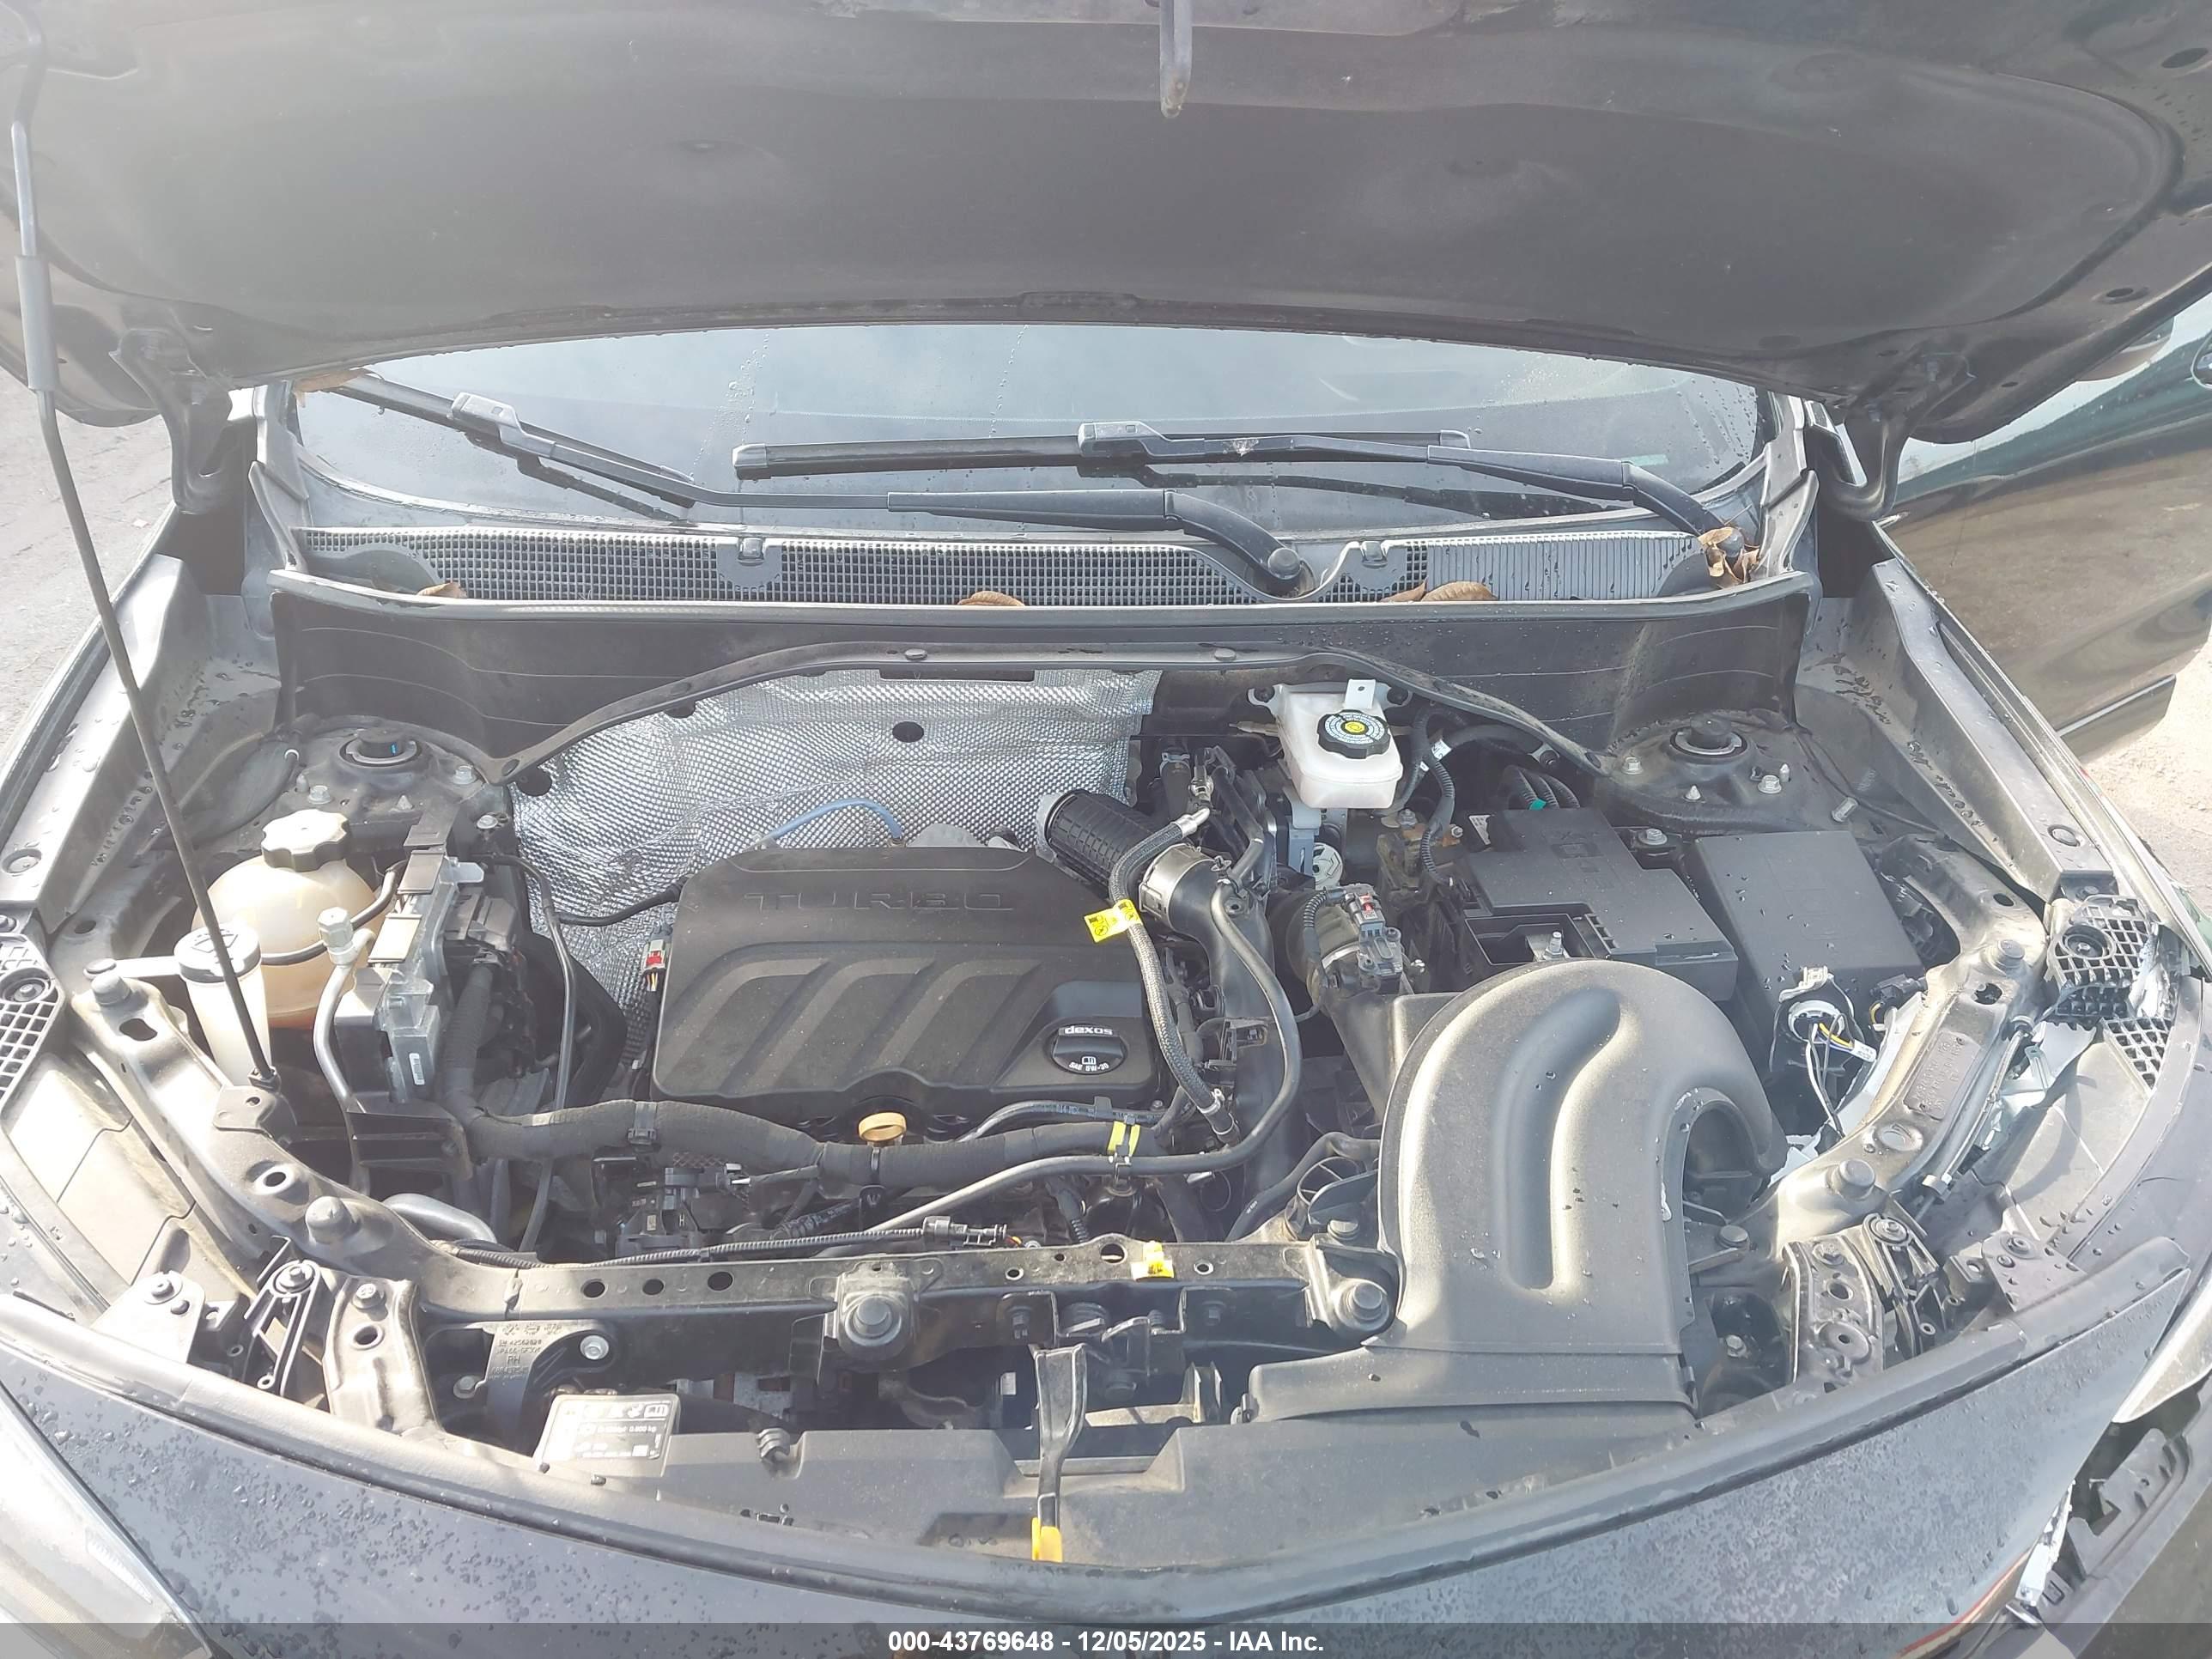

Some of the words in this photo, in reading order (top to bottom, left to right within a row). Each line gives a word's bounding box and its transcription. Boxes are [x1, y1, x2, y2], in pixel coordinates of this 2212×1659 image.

[744, 892, 1014, 911] TURBO
[1064, 1025, 1113, 1036] dexos
[1068, 1061, 1083, 1071] SAE
[1085, 1062, 1109, 1072] 5W-30
